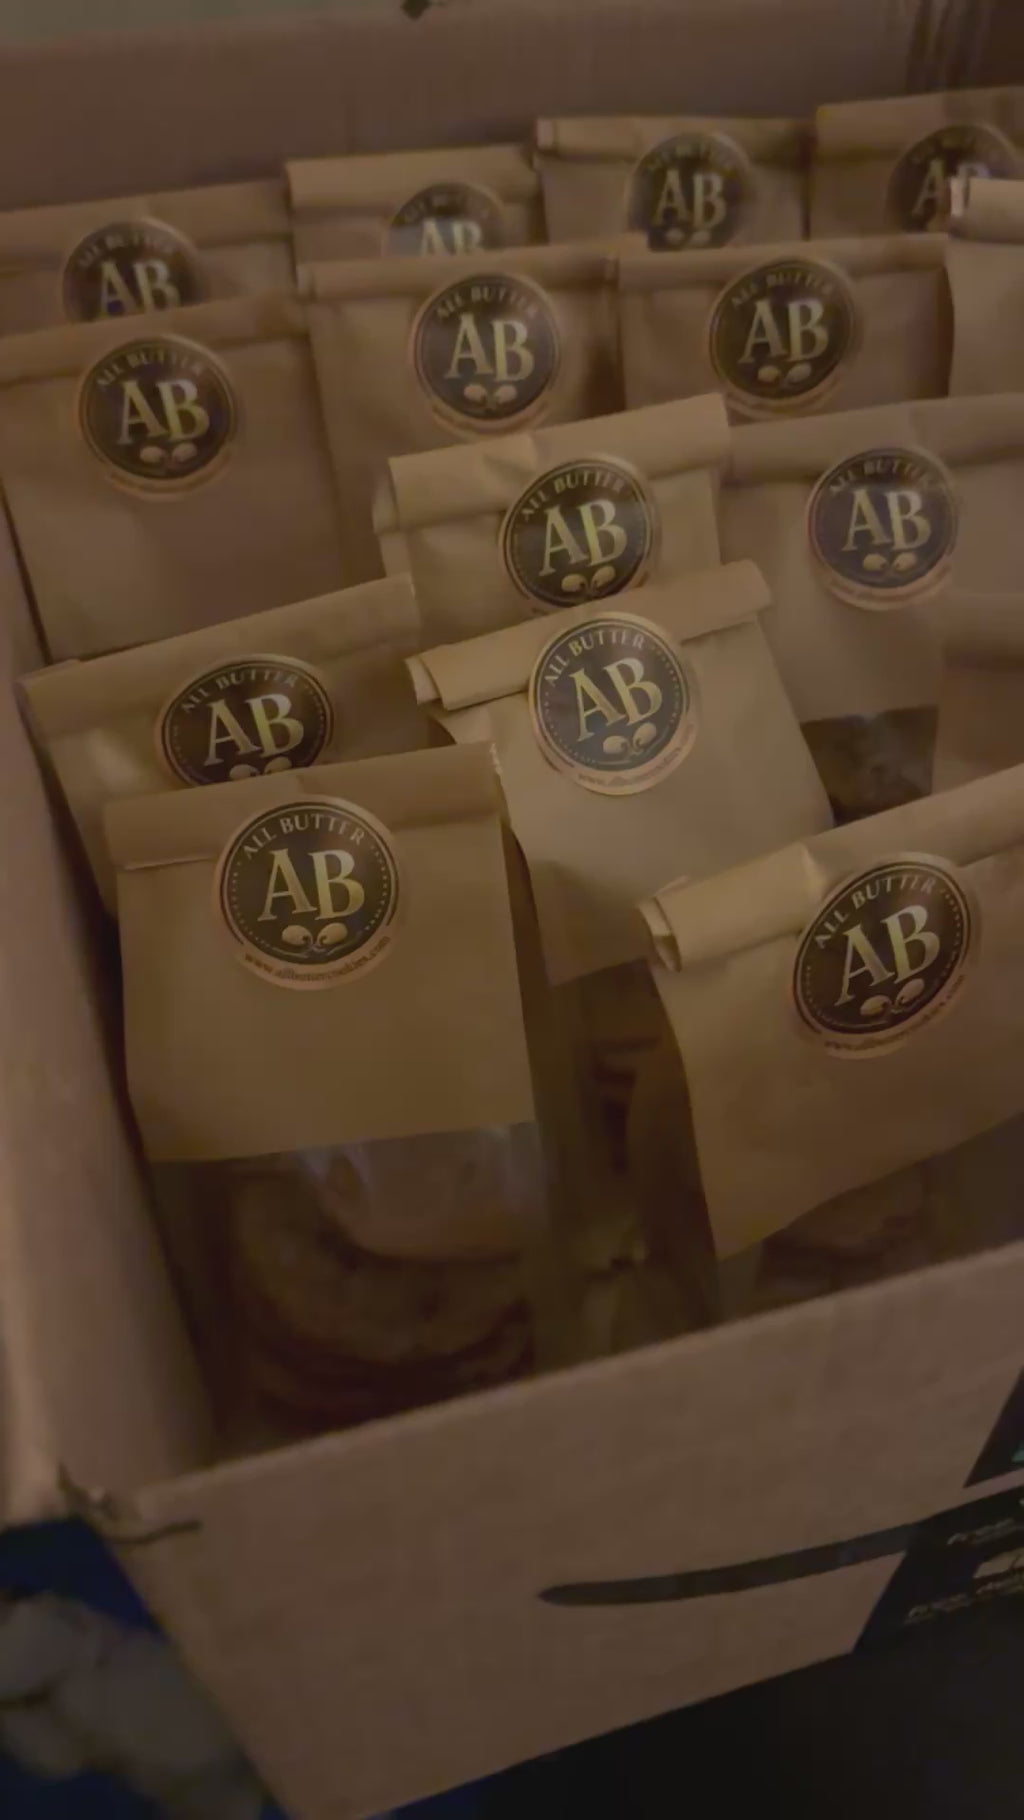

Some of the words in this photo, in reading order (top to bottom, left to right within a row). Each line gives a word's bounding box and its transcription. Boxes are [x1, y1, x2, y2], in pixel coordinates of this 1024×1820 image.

[649, 168, 727, 230] AB
[100, 259, 182, 316] AB
[444, 312, 535, 382] AB
[737, 298, 830, 364] AB
[117, 378, 210, 445] AB
[538, 499, 628, 577] AB
[841, 488, 932, 552] AB
[544, 654, 570, 688] ALL
[567, 629, 646, 657] BUTTER
[203, 693, 305, 767] AB
[568, 656, 663, 742] AB
[243, 828, 278, 861] ALL
[279, 812, 367, 846] BUTTER
[257, 847, 366, 922] AB
[813, 909, 849, 950] ALL
[850, 873, 937, 910] BUTTER
[833, 904, 941, 1007] AB
